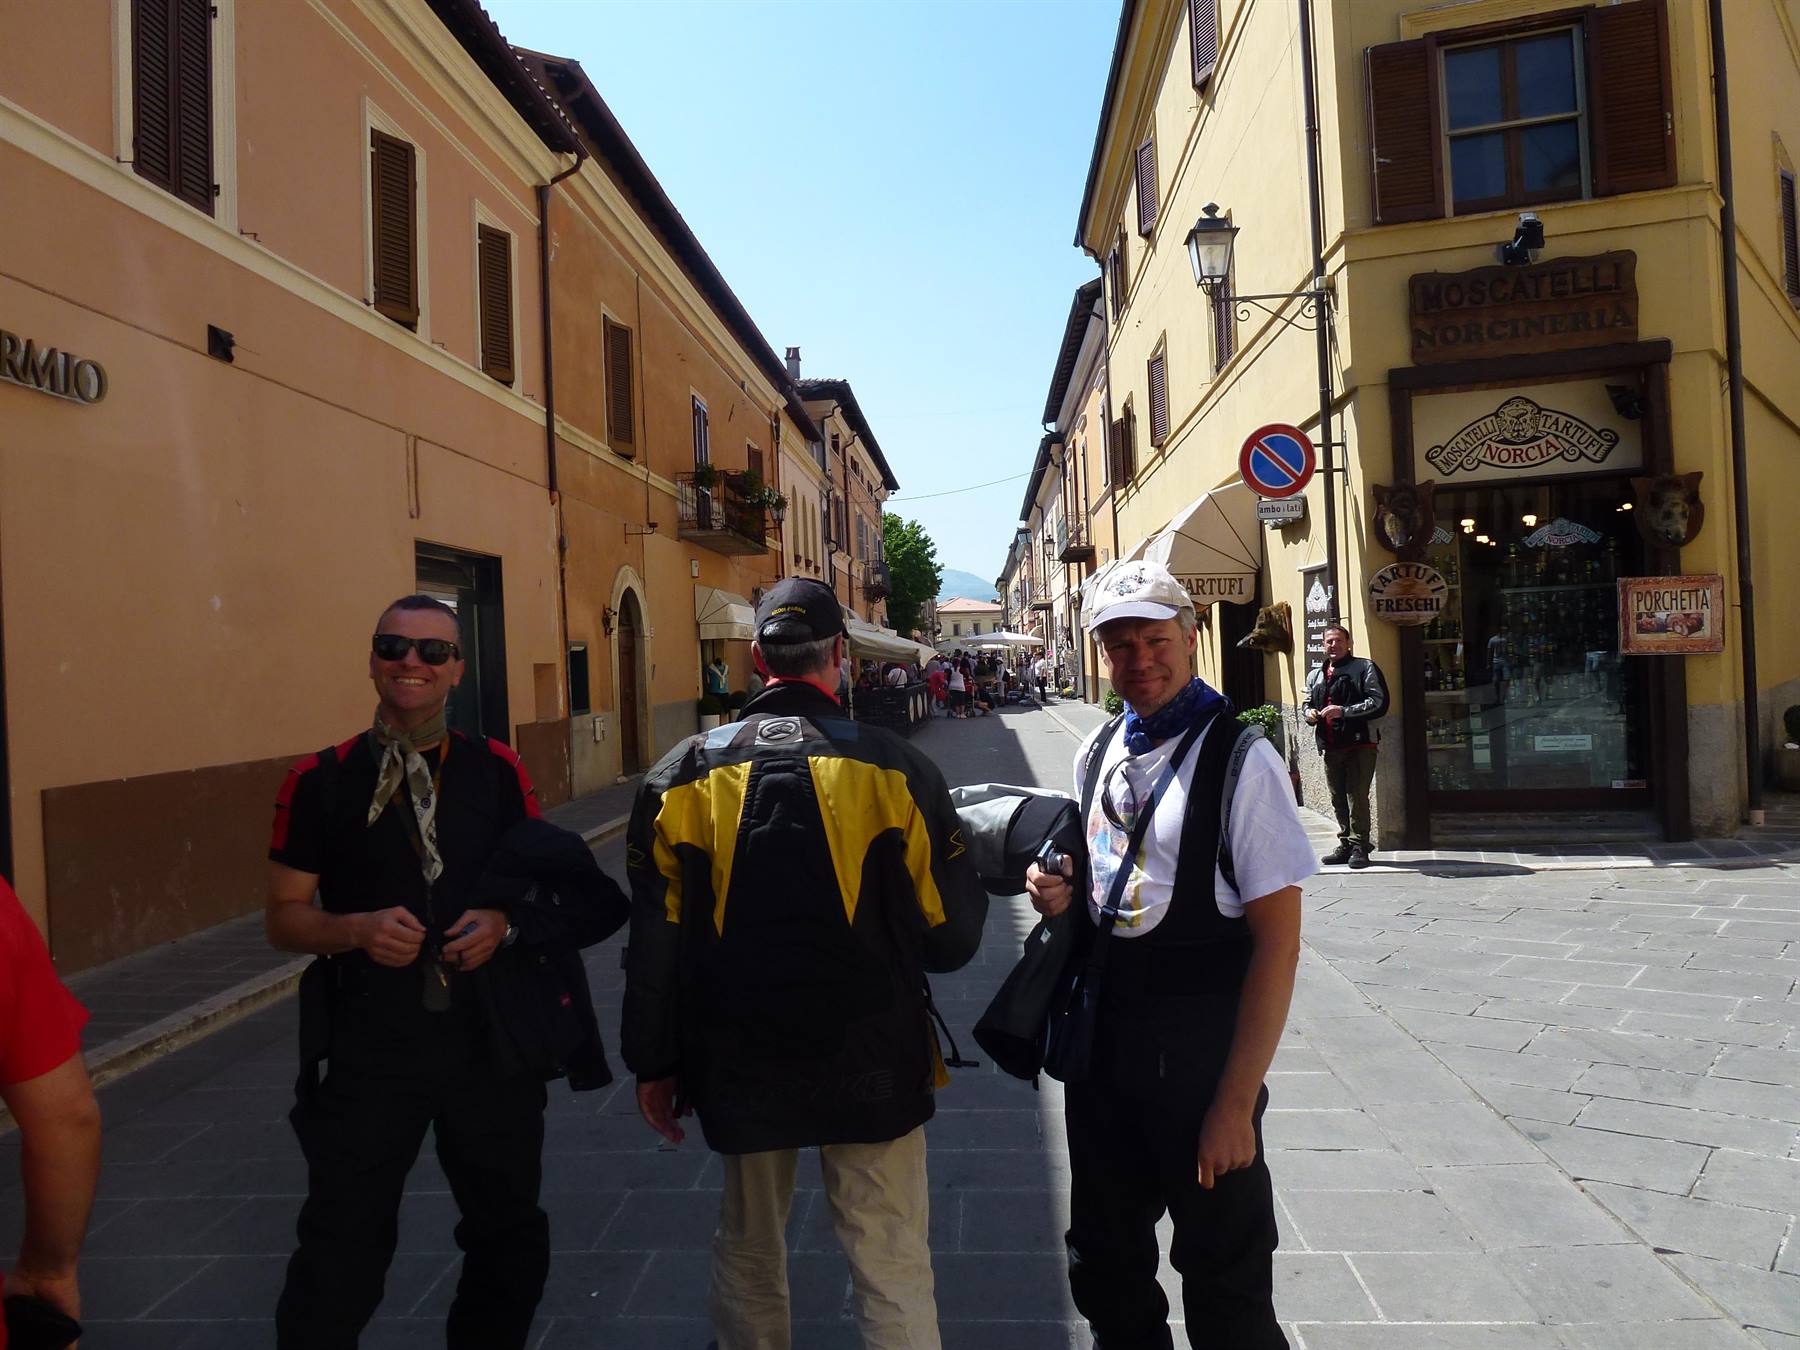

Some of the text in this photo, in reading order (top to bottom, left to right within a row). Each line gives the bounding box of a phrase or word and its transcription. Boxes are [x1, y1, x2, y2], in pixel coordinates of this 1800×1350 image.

[1422, 261, 1622, 312] MOSCATELLI
[1414, 303, 1633, 348] NORCINERIA
[1439, 412, 1603, 470] MOSCATELLI TARTUFI
[1482, 437, 1561, 465] NORCIA
[1259, 504, 1281, 513] ambo
[1547, 532, 1579, 545] NORCIA
[1370, 566, 1445, 594] TARTUFI
[1376, 598, 1440, 612] FRESCHI
[1636, 587, 1710, 611] PORCHETTA
